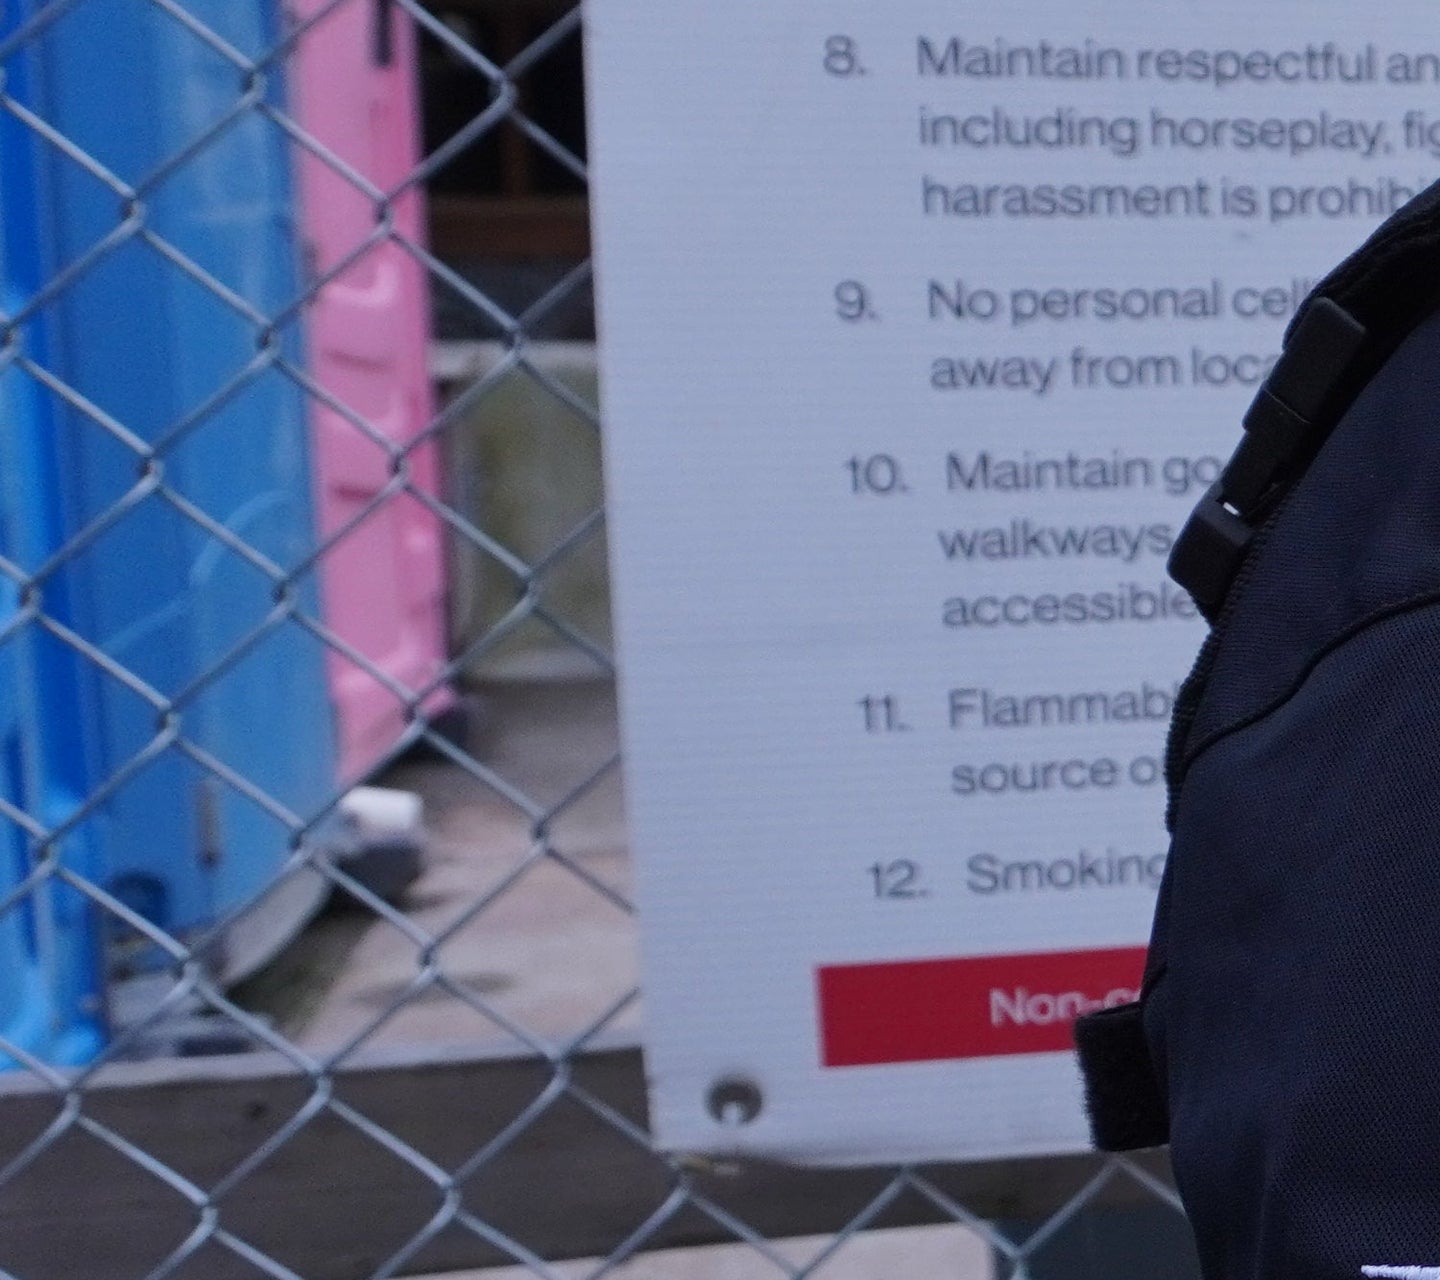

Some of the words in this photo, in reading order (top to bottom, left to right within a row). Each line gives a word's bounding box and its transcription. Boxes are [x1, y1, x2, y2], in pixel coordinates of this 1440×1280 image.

[822, 33, 870, 80] 8.
[915, 34, 1128, 82] Maintain
[1135, 41, 1378, 89] respectful
[918, 107, 1142, 160] including
[1149, 109, 1393, 160] horseplay,
[920, 176, 1211, 220] harassment
[1219, 184, 1261, 220] is
[833, 278, 880, 325] 9.
[926, 278, 1002, 323] No
[1008, 280, 1224, 328] personal
[929, 356, 1060, 398] away
[1068, 346, 1182, 390] from
[845, 452, 912, 497] 10.
[944, 450, 1155, 494] Maintain
[950, 756, 1121, 798] source
[867, 858, 931, 901] 12.
